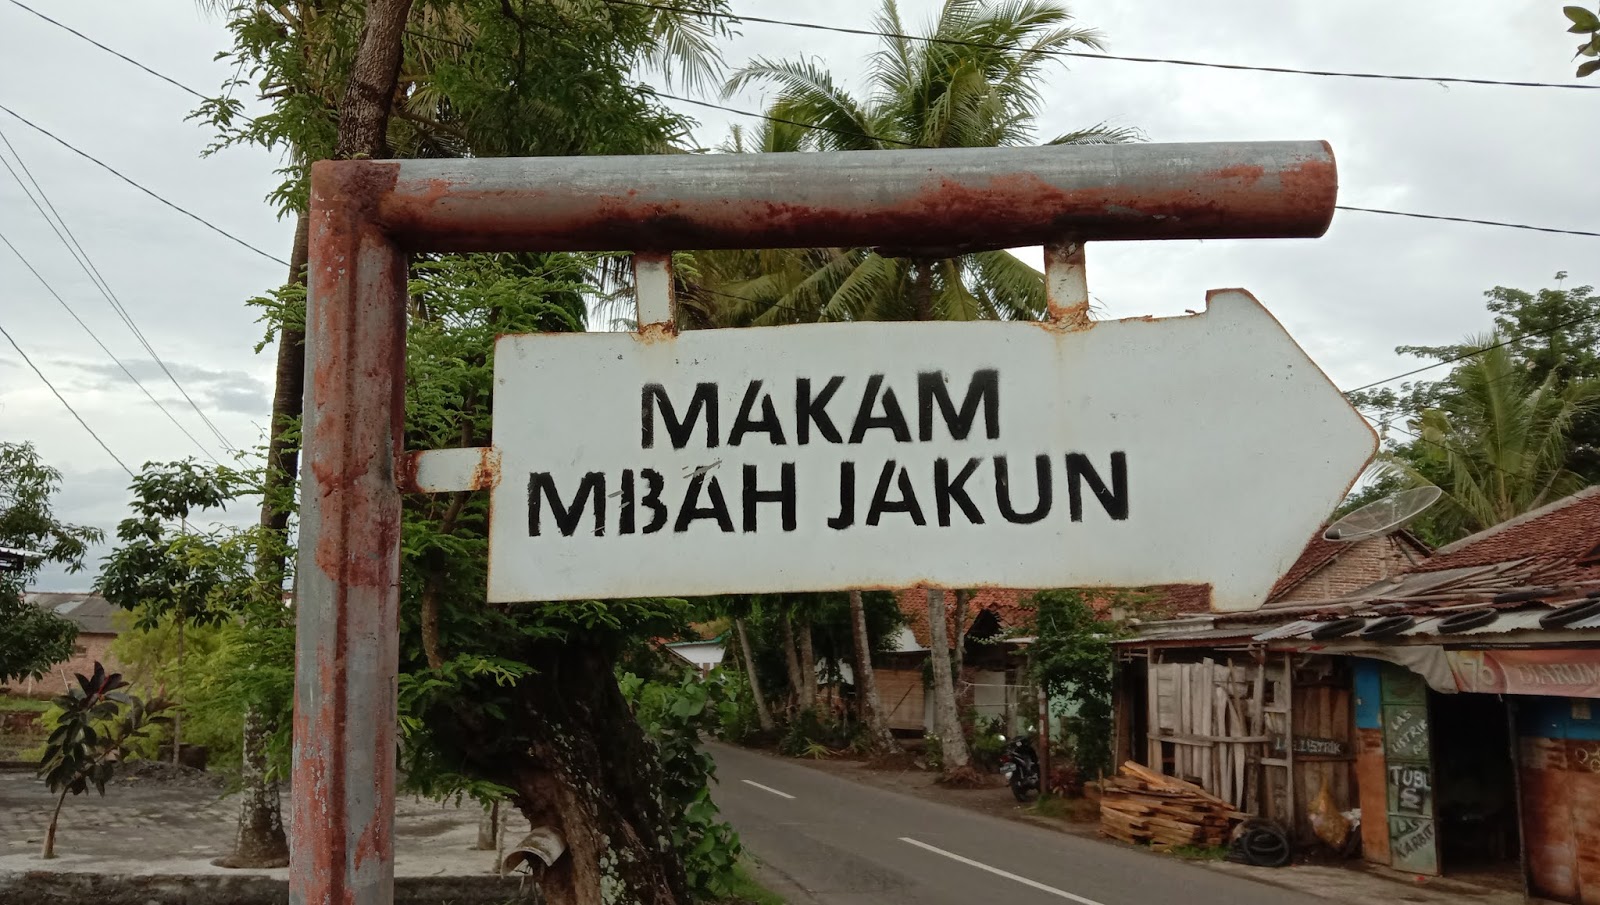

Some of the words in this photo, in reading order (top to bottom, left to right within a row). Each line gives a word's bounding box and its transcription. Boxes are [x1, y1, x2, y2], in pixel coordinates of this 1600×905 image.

[641, 368, 1000, 451] MAKAM
[527, 460, 797, 539] MBAH
[827, 450, 1130, 531] JAKUN
